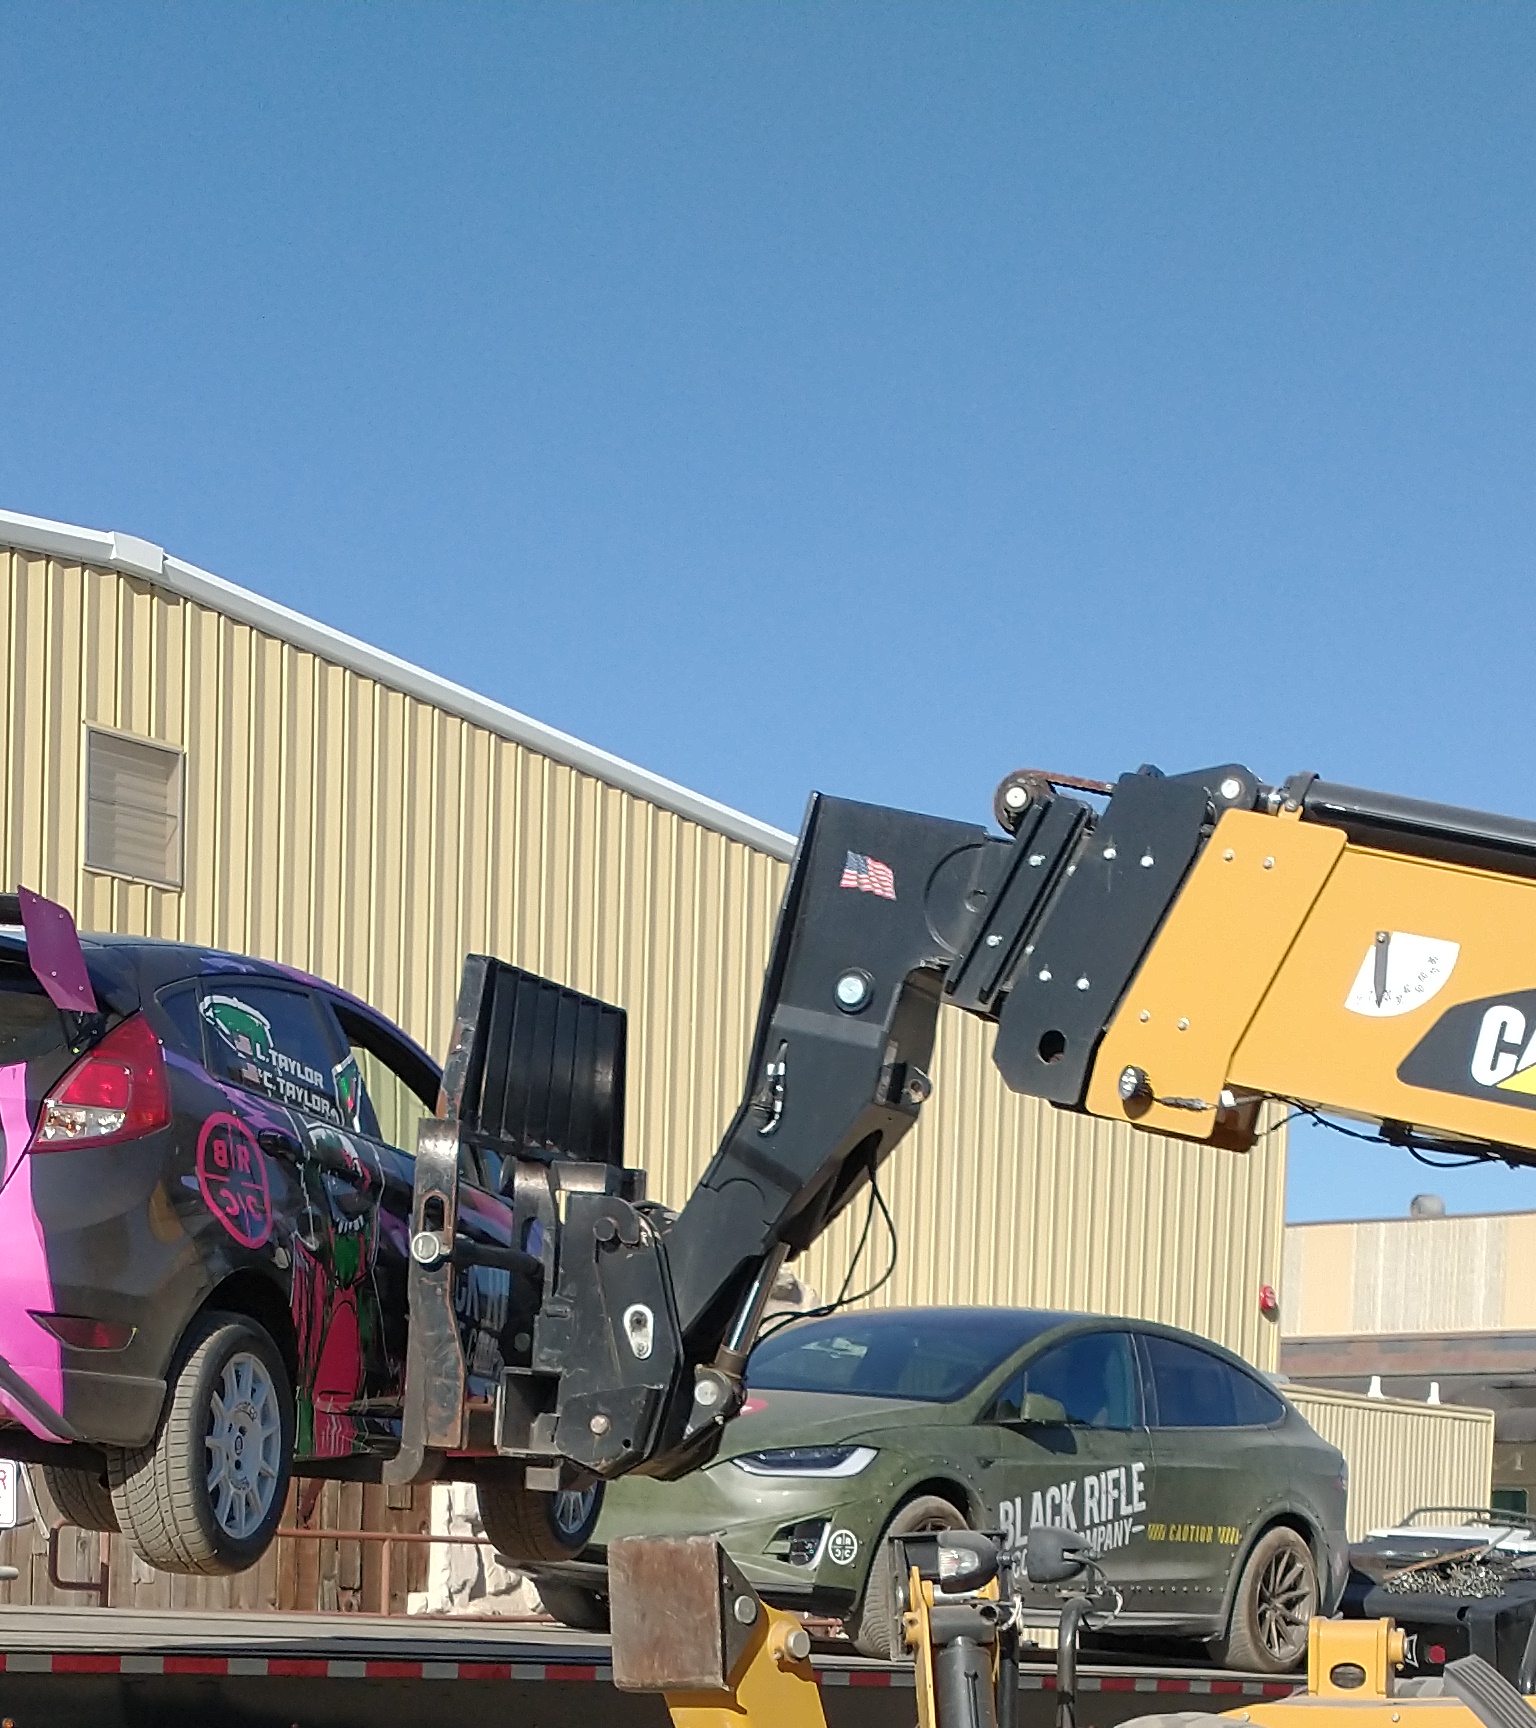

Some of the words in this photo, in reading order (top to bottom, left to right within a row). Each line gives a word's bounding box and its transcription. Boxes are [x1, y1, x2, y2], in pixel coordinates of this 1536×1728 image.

[999, 1480, 1077, 1550] BLACK
[1083, 1461, 1147, 1527] RIFLE
[1168, 1524, 1214, 1543] CAUTION
